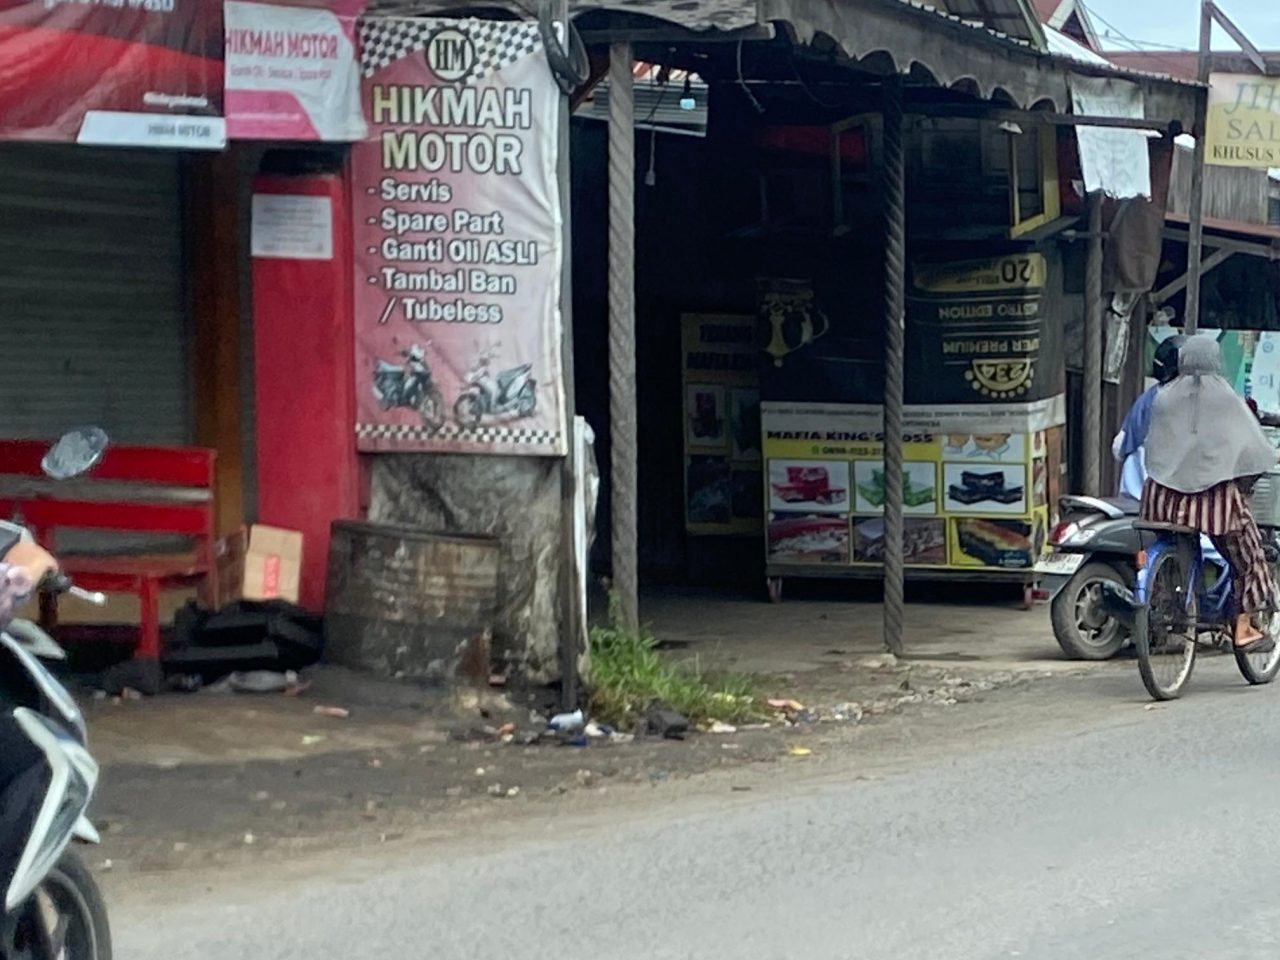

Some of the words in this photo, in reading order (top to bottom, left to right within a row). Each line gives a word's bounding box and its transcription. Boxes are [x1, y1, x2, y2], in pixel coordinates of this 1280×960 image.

[226, 28, 285, 58] HIKMAH
[286, 32, 338, 60] MOTOR
[434, 38, 468, 71] HM
[372, 84, 532, 129] HIKMAH
[381, 130, 523, 176] MOTOR
[1212, 143, 1274, 162] KHUSUS
[380, 178, 452, 203] Servis
[380, 208, 449, 236] Spare
[452, 209, 504, 234] Part
[381, 237, 444, 262] Ganti
[448, 239, 481, 264] Oli
[483, 240, 538, 265] ASLI
[380, 266, 465, 293] Tambal
[468, 269, 517, 294] Ban
[1001, 259, 1030, 284] 20
[401, 297, 504, 324] Tubeless
[938, 303, 993, 319] EDITION
[942, 341, 1008, 354] PREMIUM
[767, 430, 821, 441] MAFIA
[826, 431, 886, 443] KING'S
[901, 433, 934, 443] OSS
